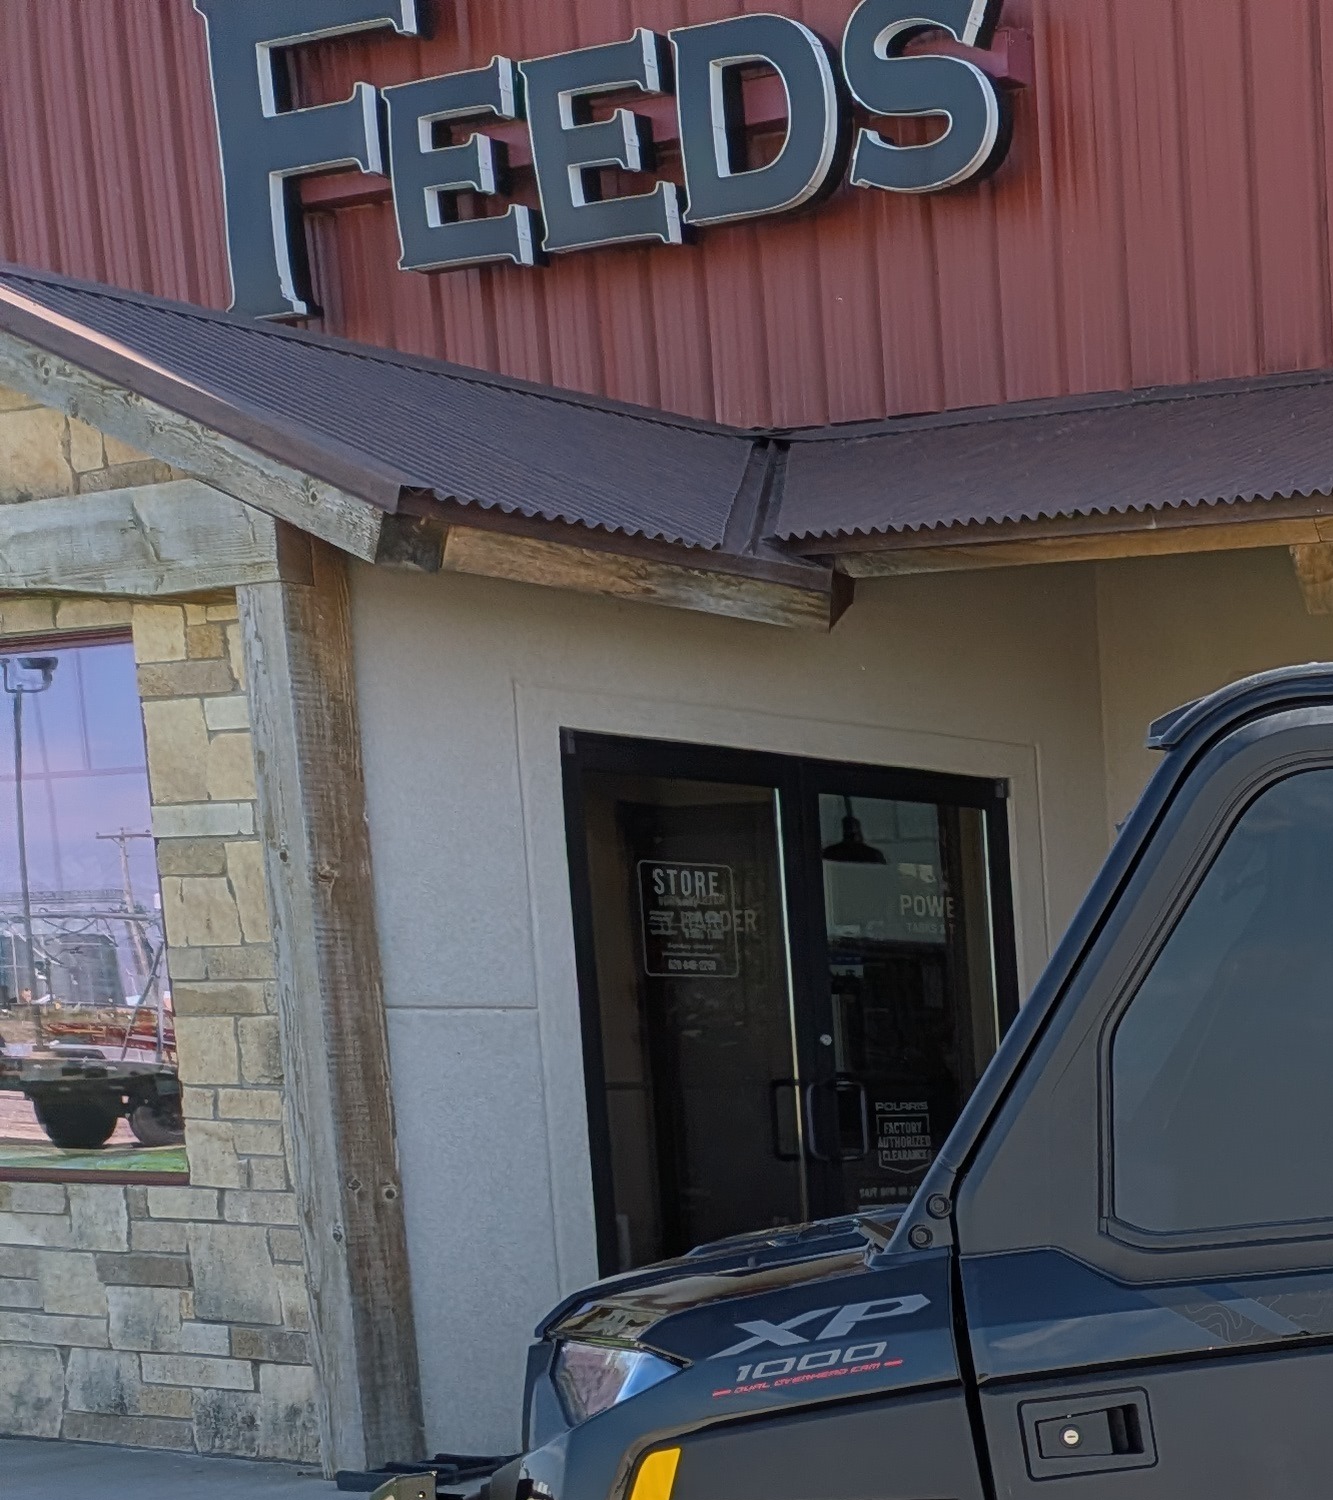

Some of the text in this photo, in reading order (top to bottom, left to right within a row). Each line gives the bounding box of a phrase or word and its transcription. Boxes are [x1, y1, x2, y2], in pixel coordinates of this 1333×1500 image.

[195, 0, 1006, 320] FEEDS
[652, 868, 720, 899] STORE
[875, 1101, 928, 1111] POLARIS
[878, 1135, 931, 1148] AUTHORIZED
[884, 1121, 922, 1134] FACTORY
[707, 1294, 931, 1359] XP
[736, 1341, 887, 1383] 1000
[734, 1362, 881, 1394] DUAL OVERHEAD CAM
